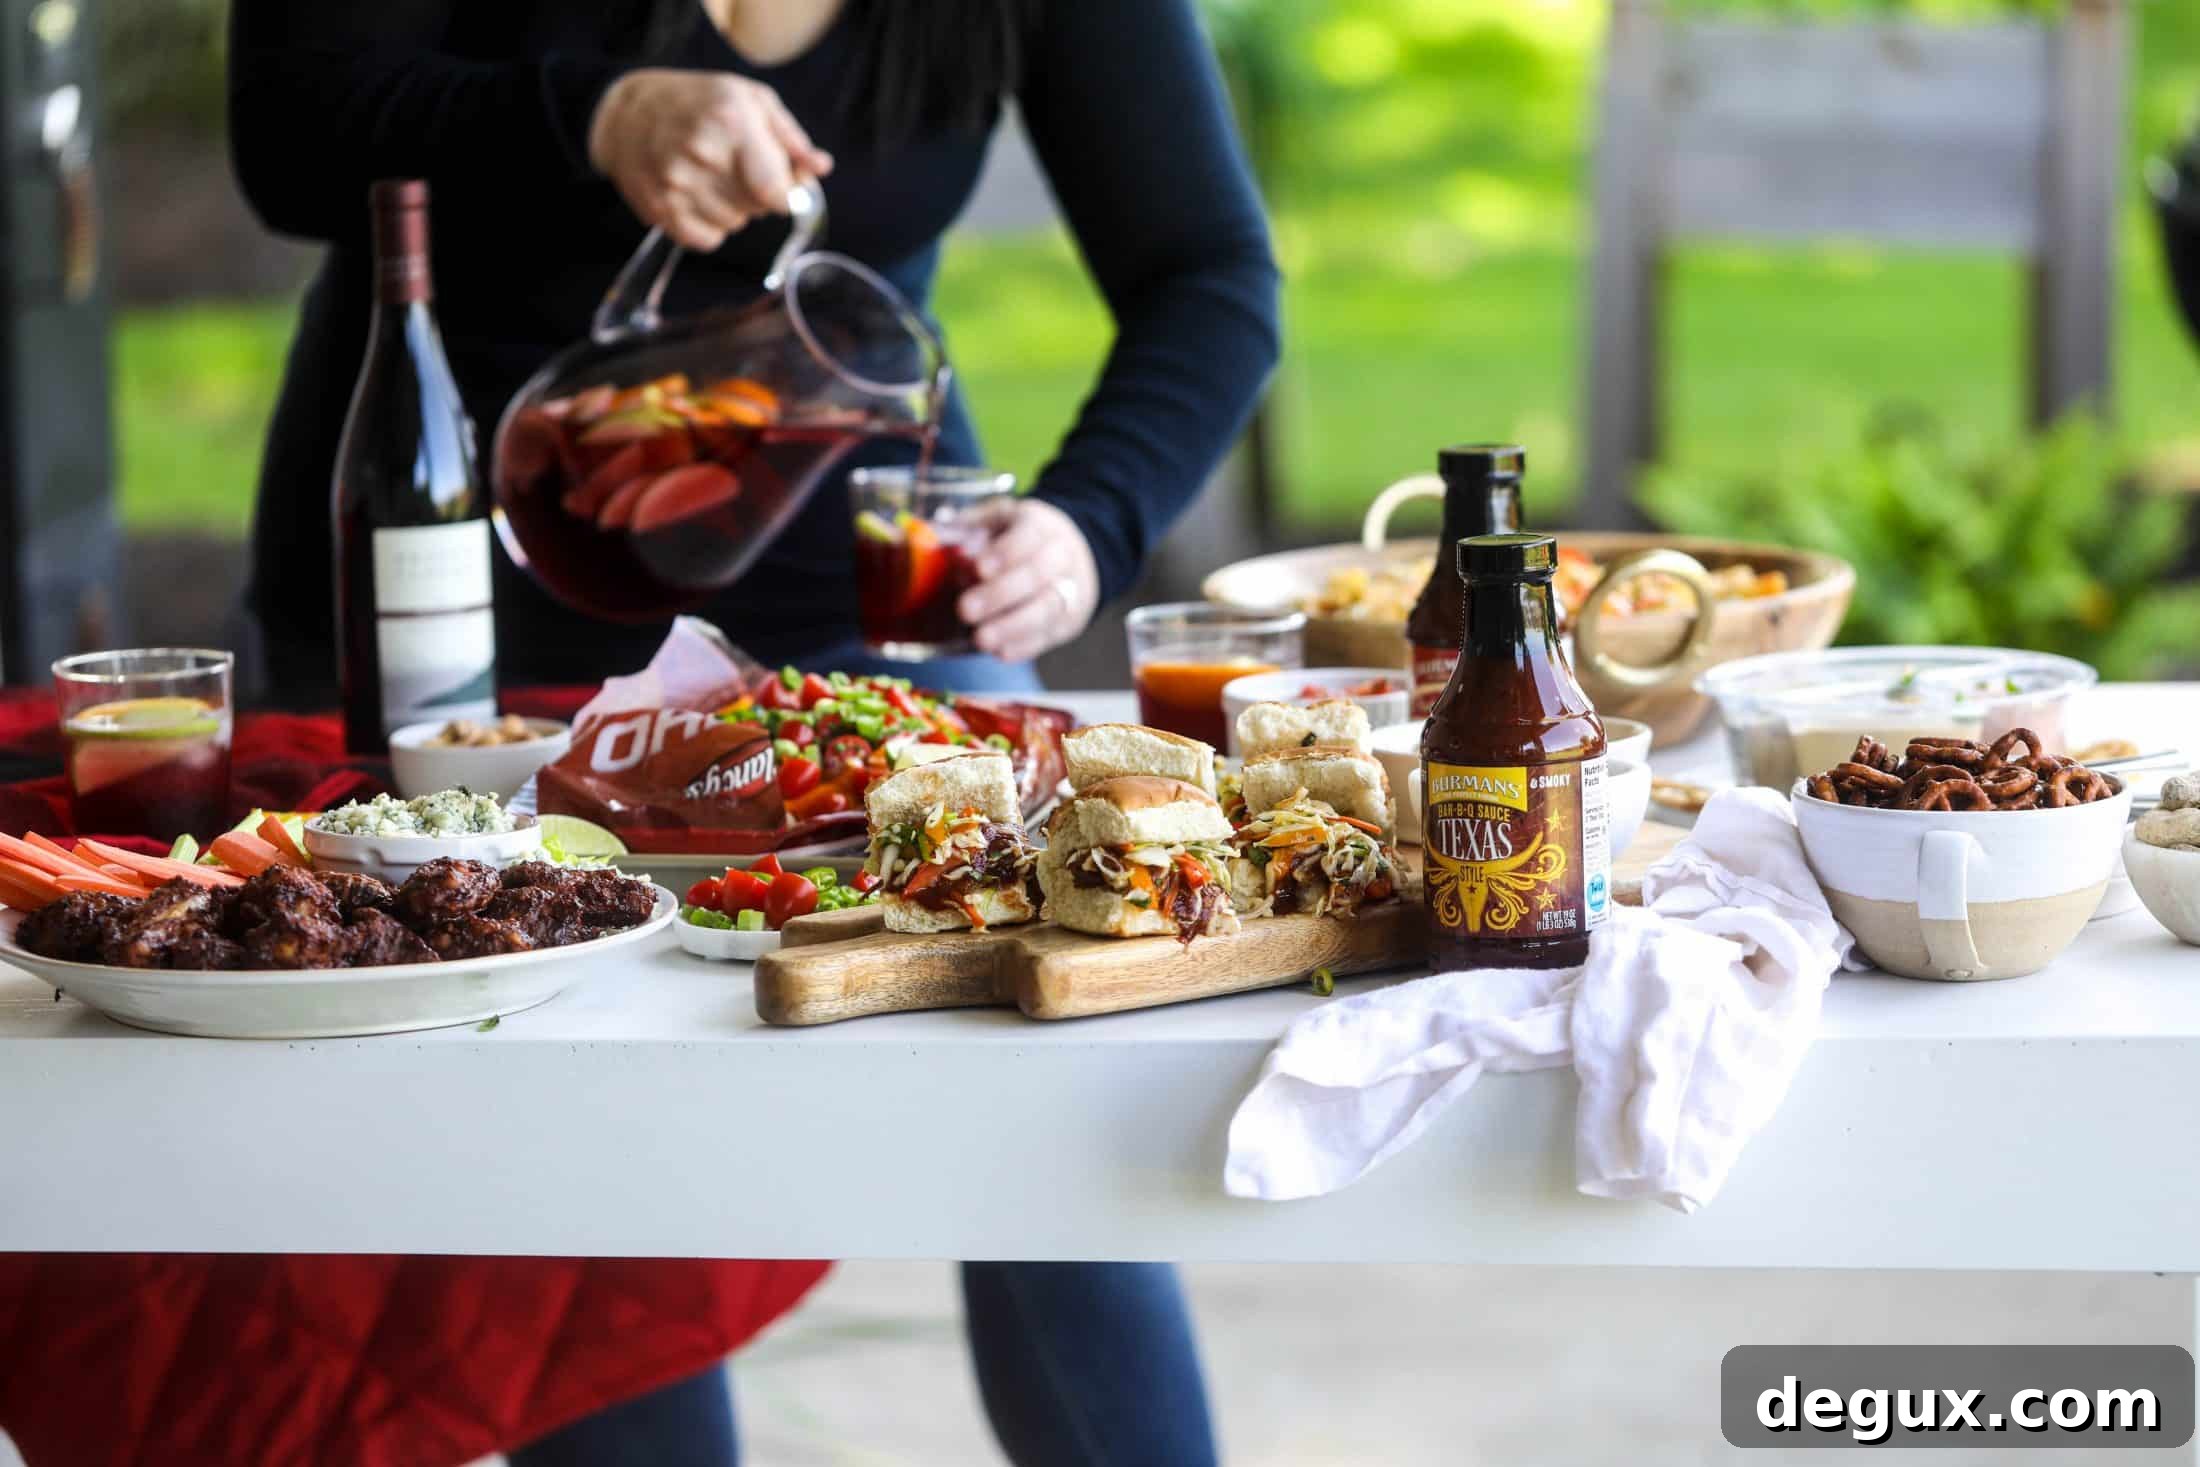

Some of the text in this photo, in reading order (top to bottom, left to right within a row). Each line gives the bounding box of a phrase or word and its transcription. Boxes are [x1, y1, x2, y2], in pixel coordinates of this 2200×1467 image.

[1539, 774, 1571, 788] SMOKY
[1438, 803, 1511, 822] BAR-B-Q SAUCE
[1438, 818, 1513, 861] TEXAS
[1459, 866, 1484, 884] STYLE
